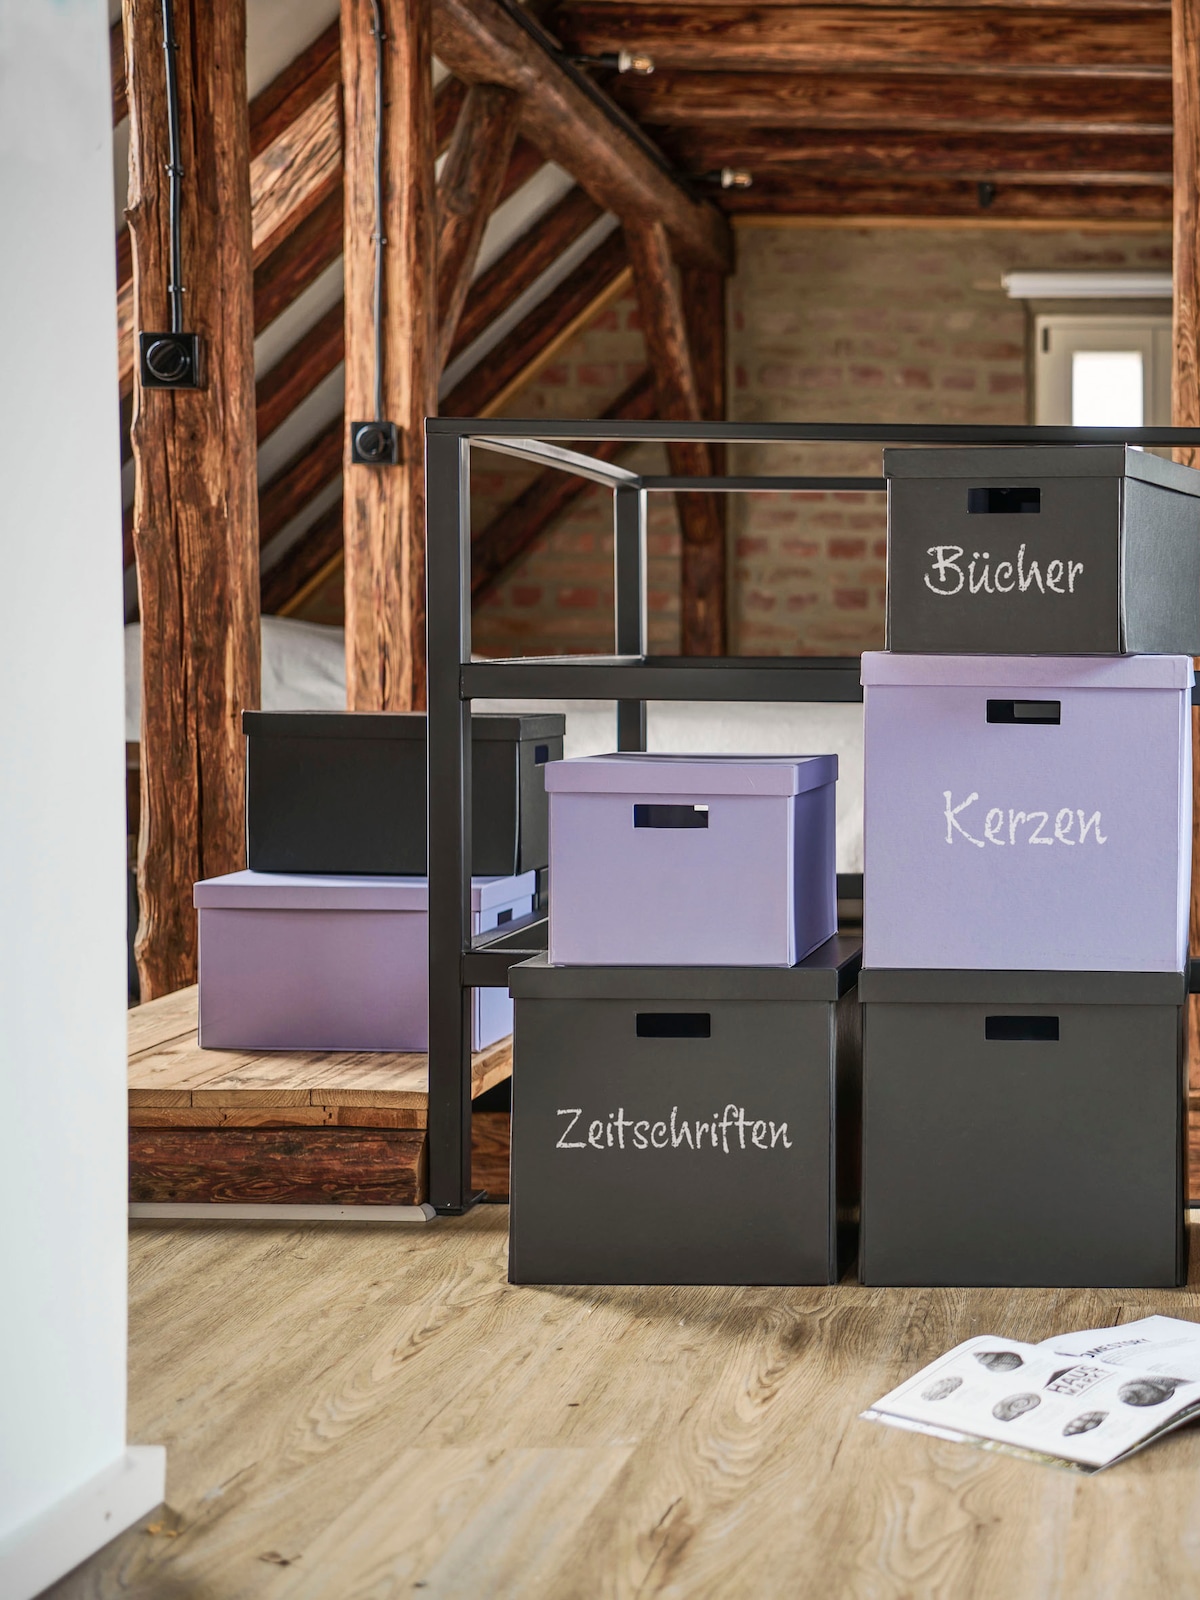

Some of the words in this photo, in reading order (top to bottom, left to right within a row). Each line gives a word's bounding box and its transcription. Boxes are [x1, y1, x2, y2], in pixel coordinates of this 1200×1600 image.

[923, 543, 1084, 596] Bücher
[943, 790, 1108, 848] Kerzen
[556, 1104, 793, 1154] Zeitschriften
[1047, 1364, 1091, 1393] HAUS
